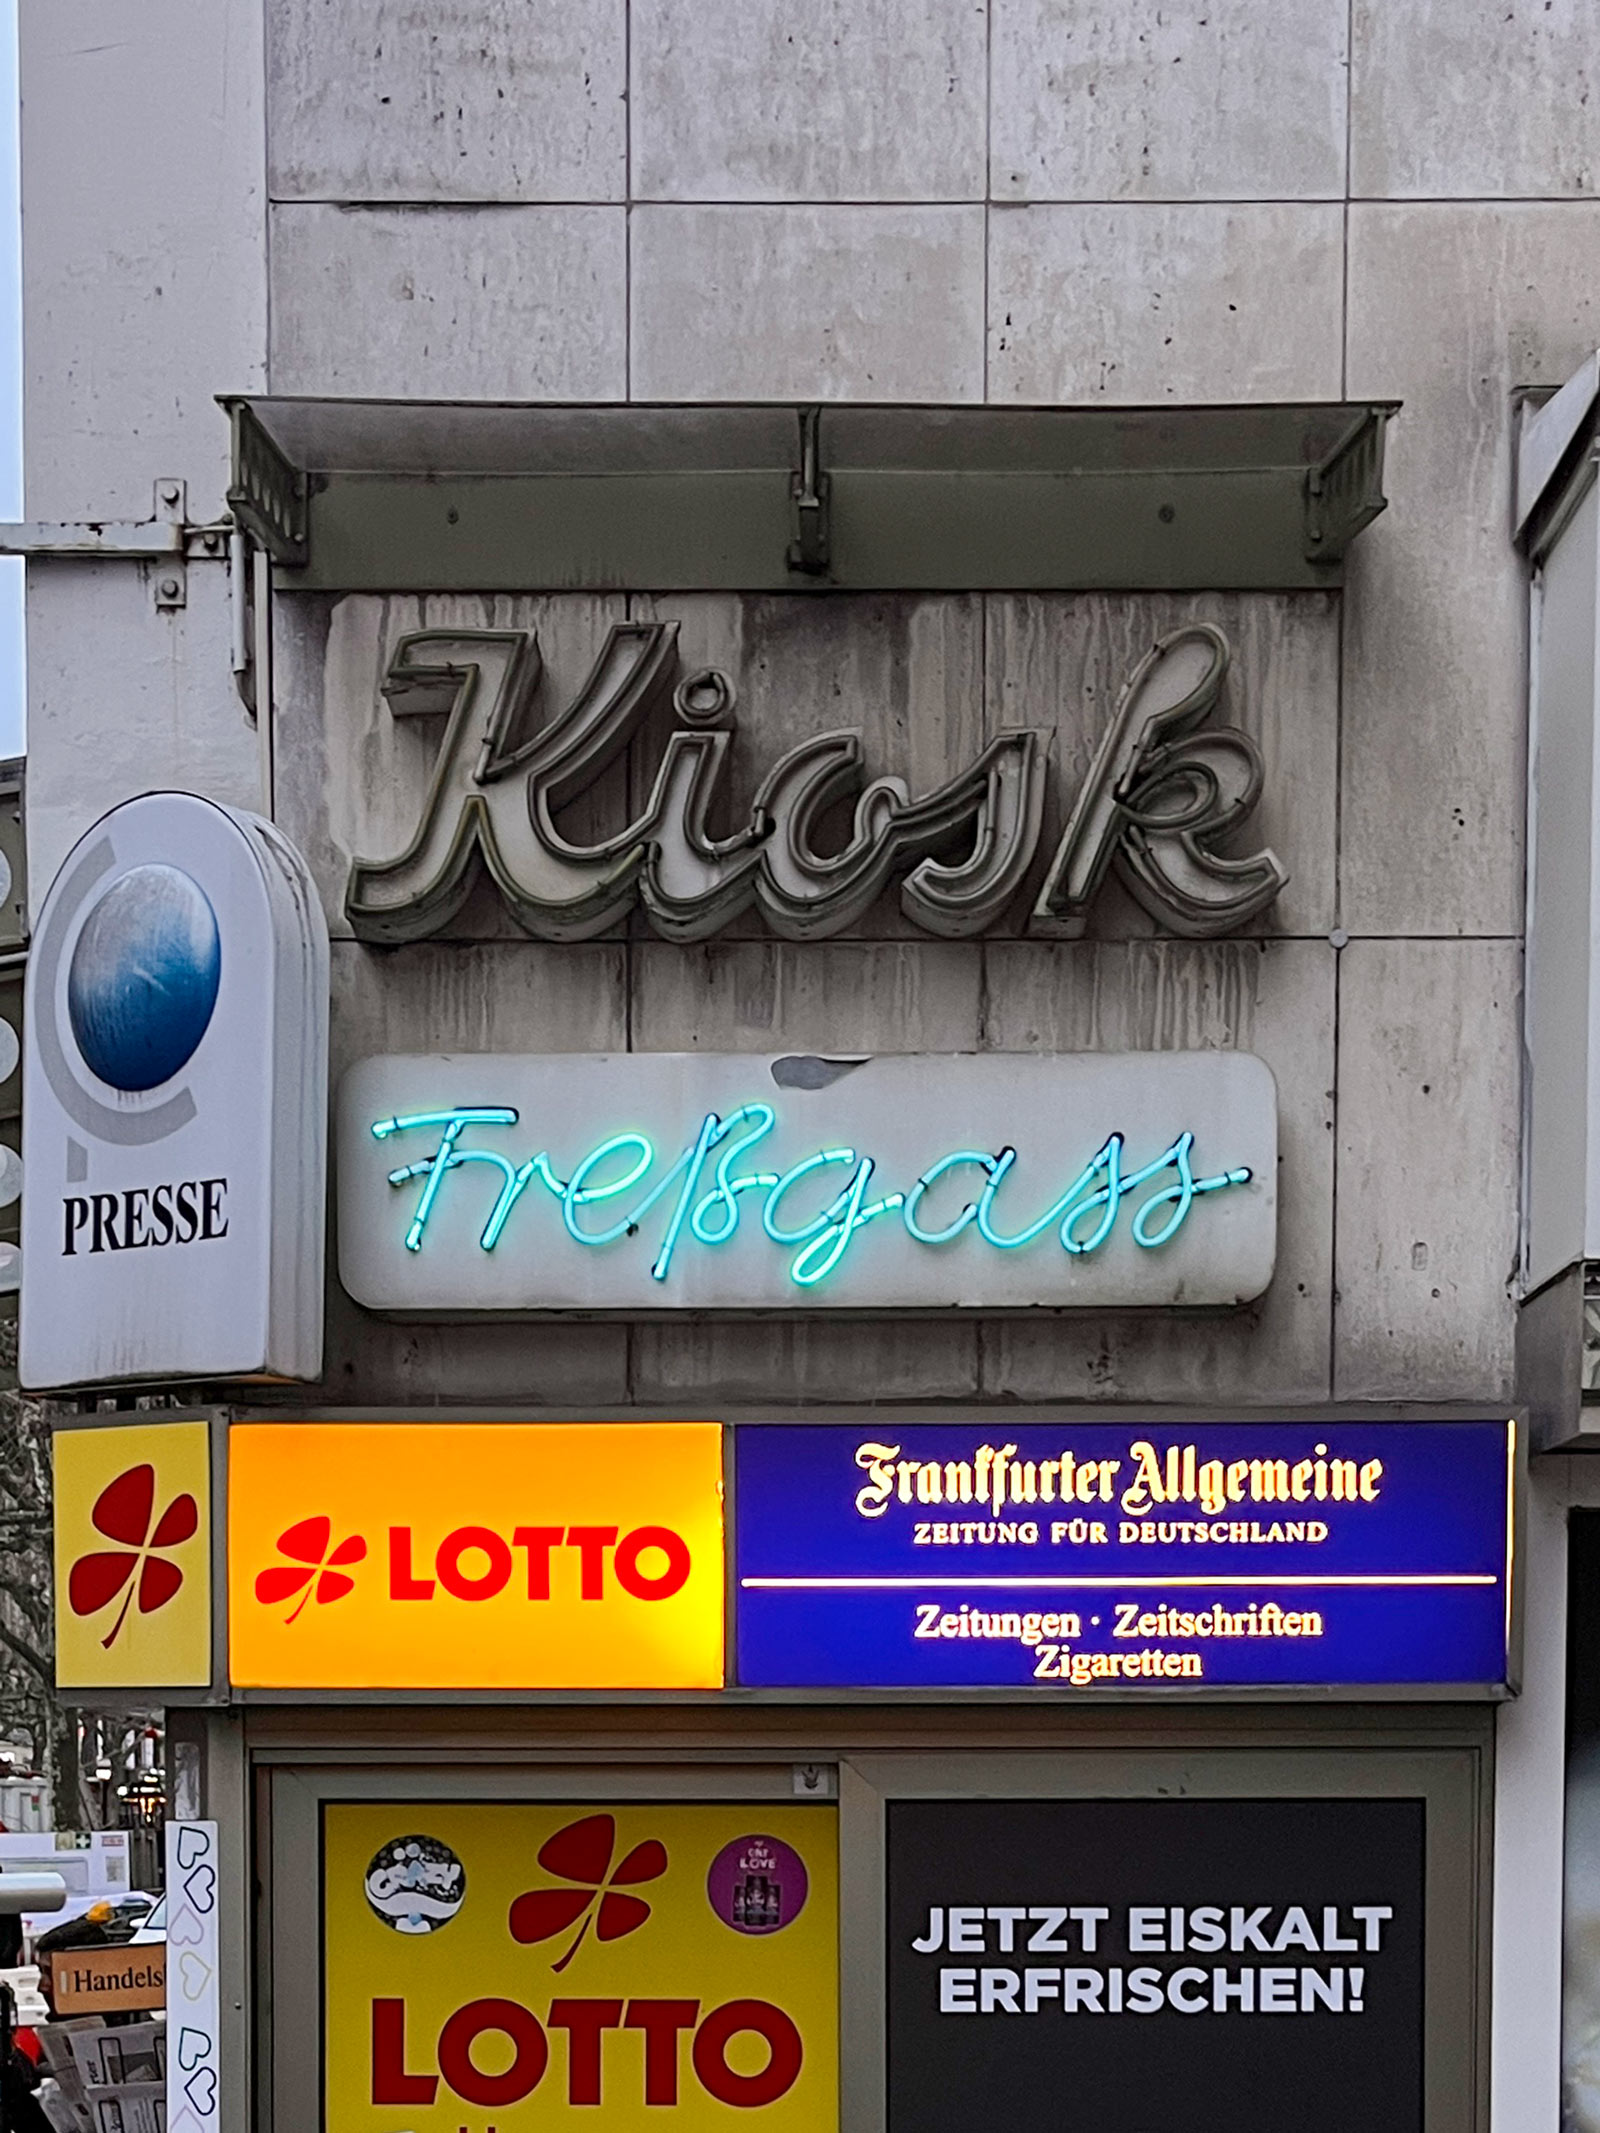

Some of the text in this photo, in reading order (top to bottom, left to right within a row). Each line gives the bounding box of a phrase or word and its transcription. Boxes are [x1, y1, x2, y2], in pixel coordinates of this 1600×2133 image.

[344, 618, 1292, 945] Kiosk
[61, 1177, 229, 1256] PRESSE
[854, 1440, 1384, 1518] Frankfurter Allgemeine
[913, 1517, 1329, 1545] ZEITUNG FÜR DEUTSCHLAND
[388, 1526, 691, 1601] LOTTO
[914, 1603, 1323, 1645] Zeitungen Zeitschriften
[1033, 1645, 1203, 1685] Zigaretten
[740, 1858, 776, 1869] LOVE
[912, 1906, 1393, 1953] JETZT EISKALT
[74, 1965, 166, 1992] Handels
[940, 1967, 1365, 2013] ERFRISCHEN!
[372, 1998, 803, 2107] LOTTO
